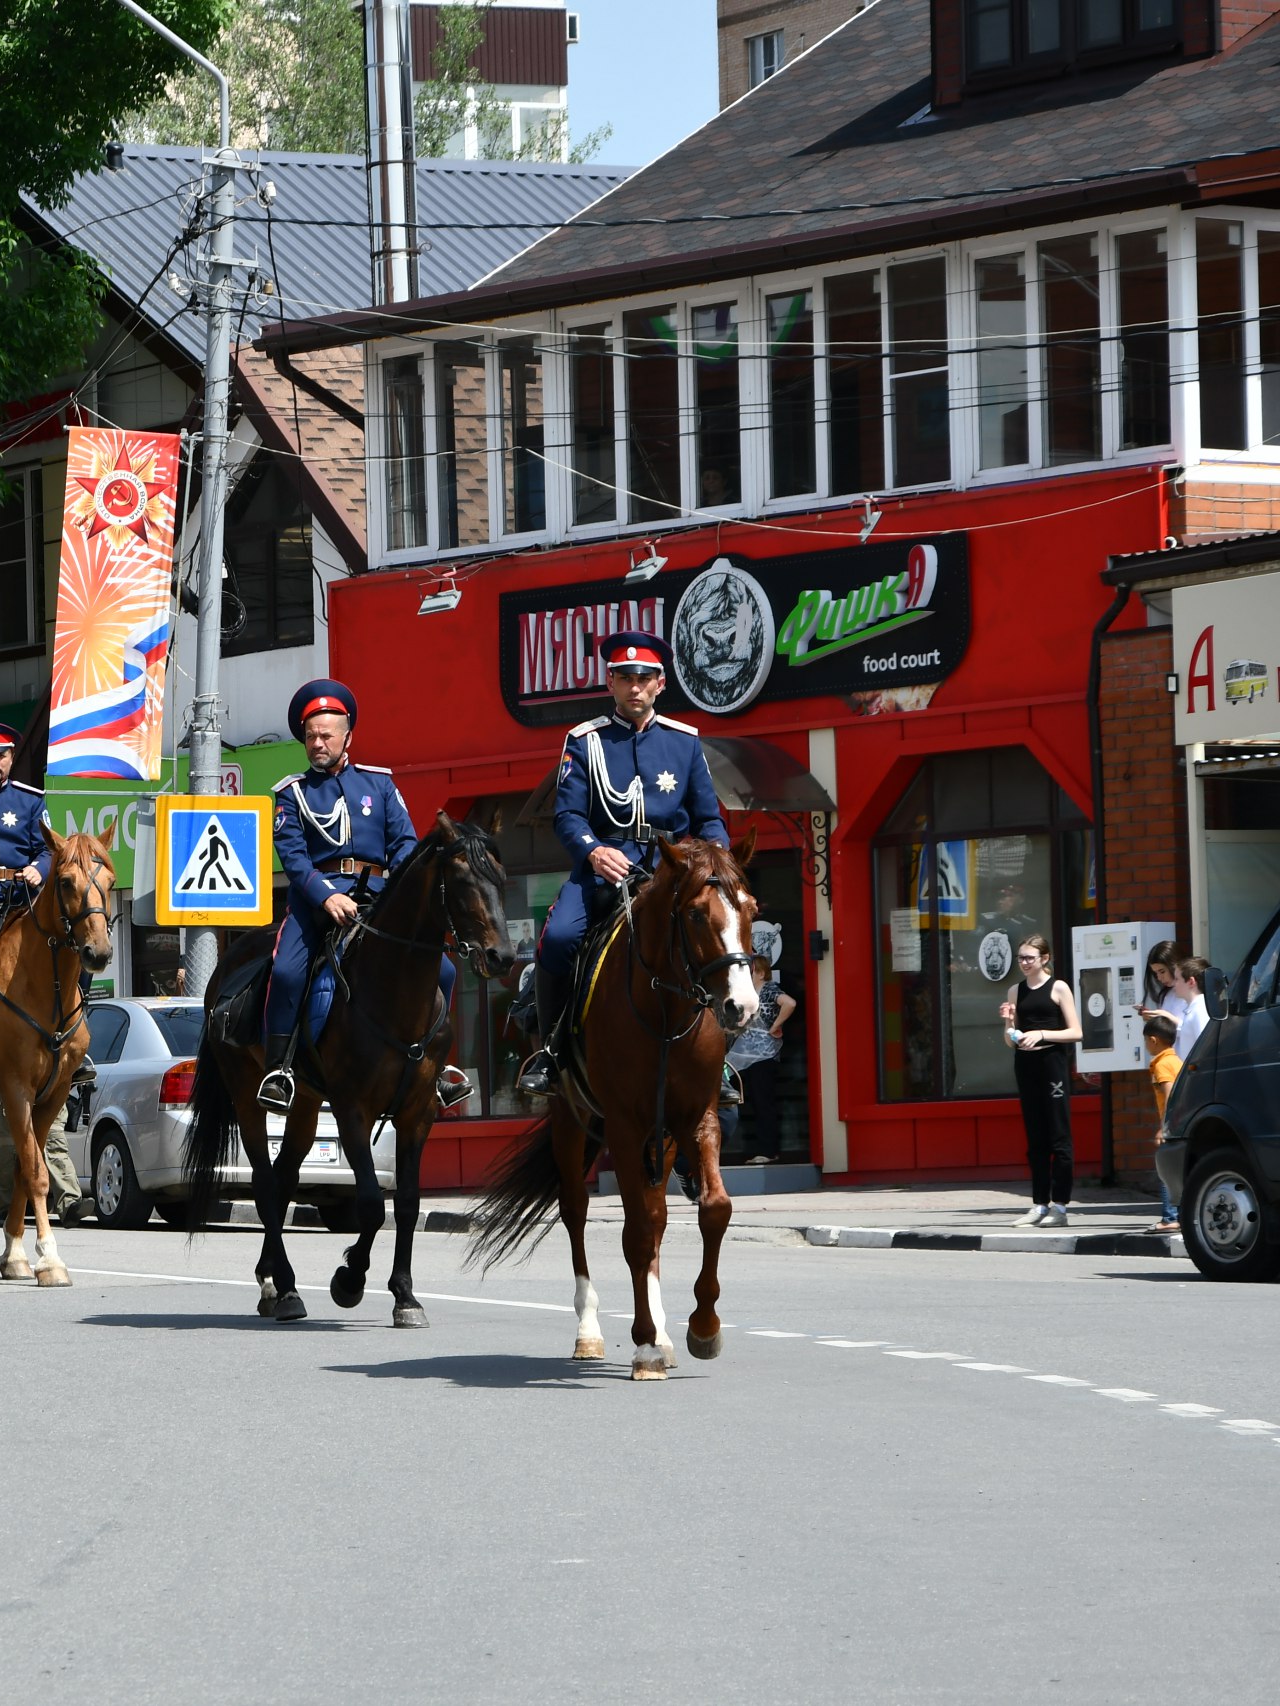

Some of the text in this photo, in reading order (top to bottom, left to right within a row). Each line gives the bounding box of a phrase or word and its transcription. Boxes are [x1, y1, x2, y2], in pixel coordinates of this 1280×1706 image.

[863, 649, 941, 673] food court
[66, 801, 138, 852] МЯС
